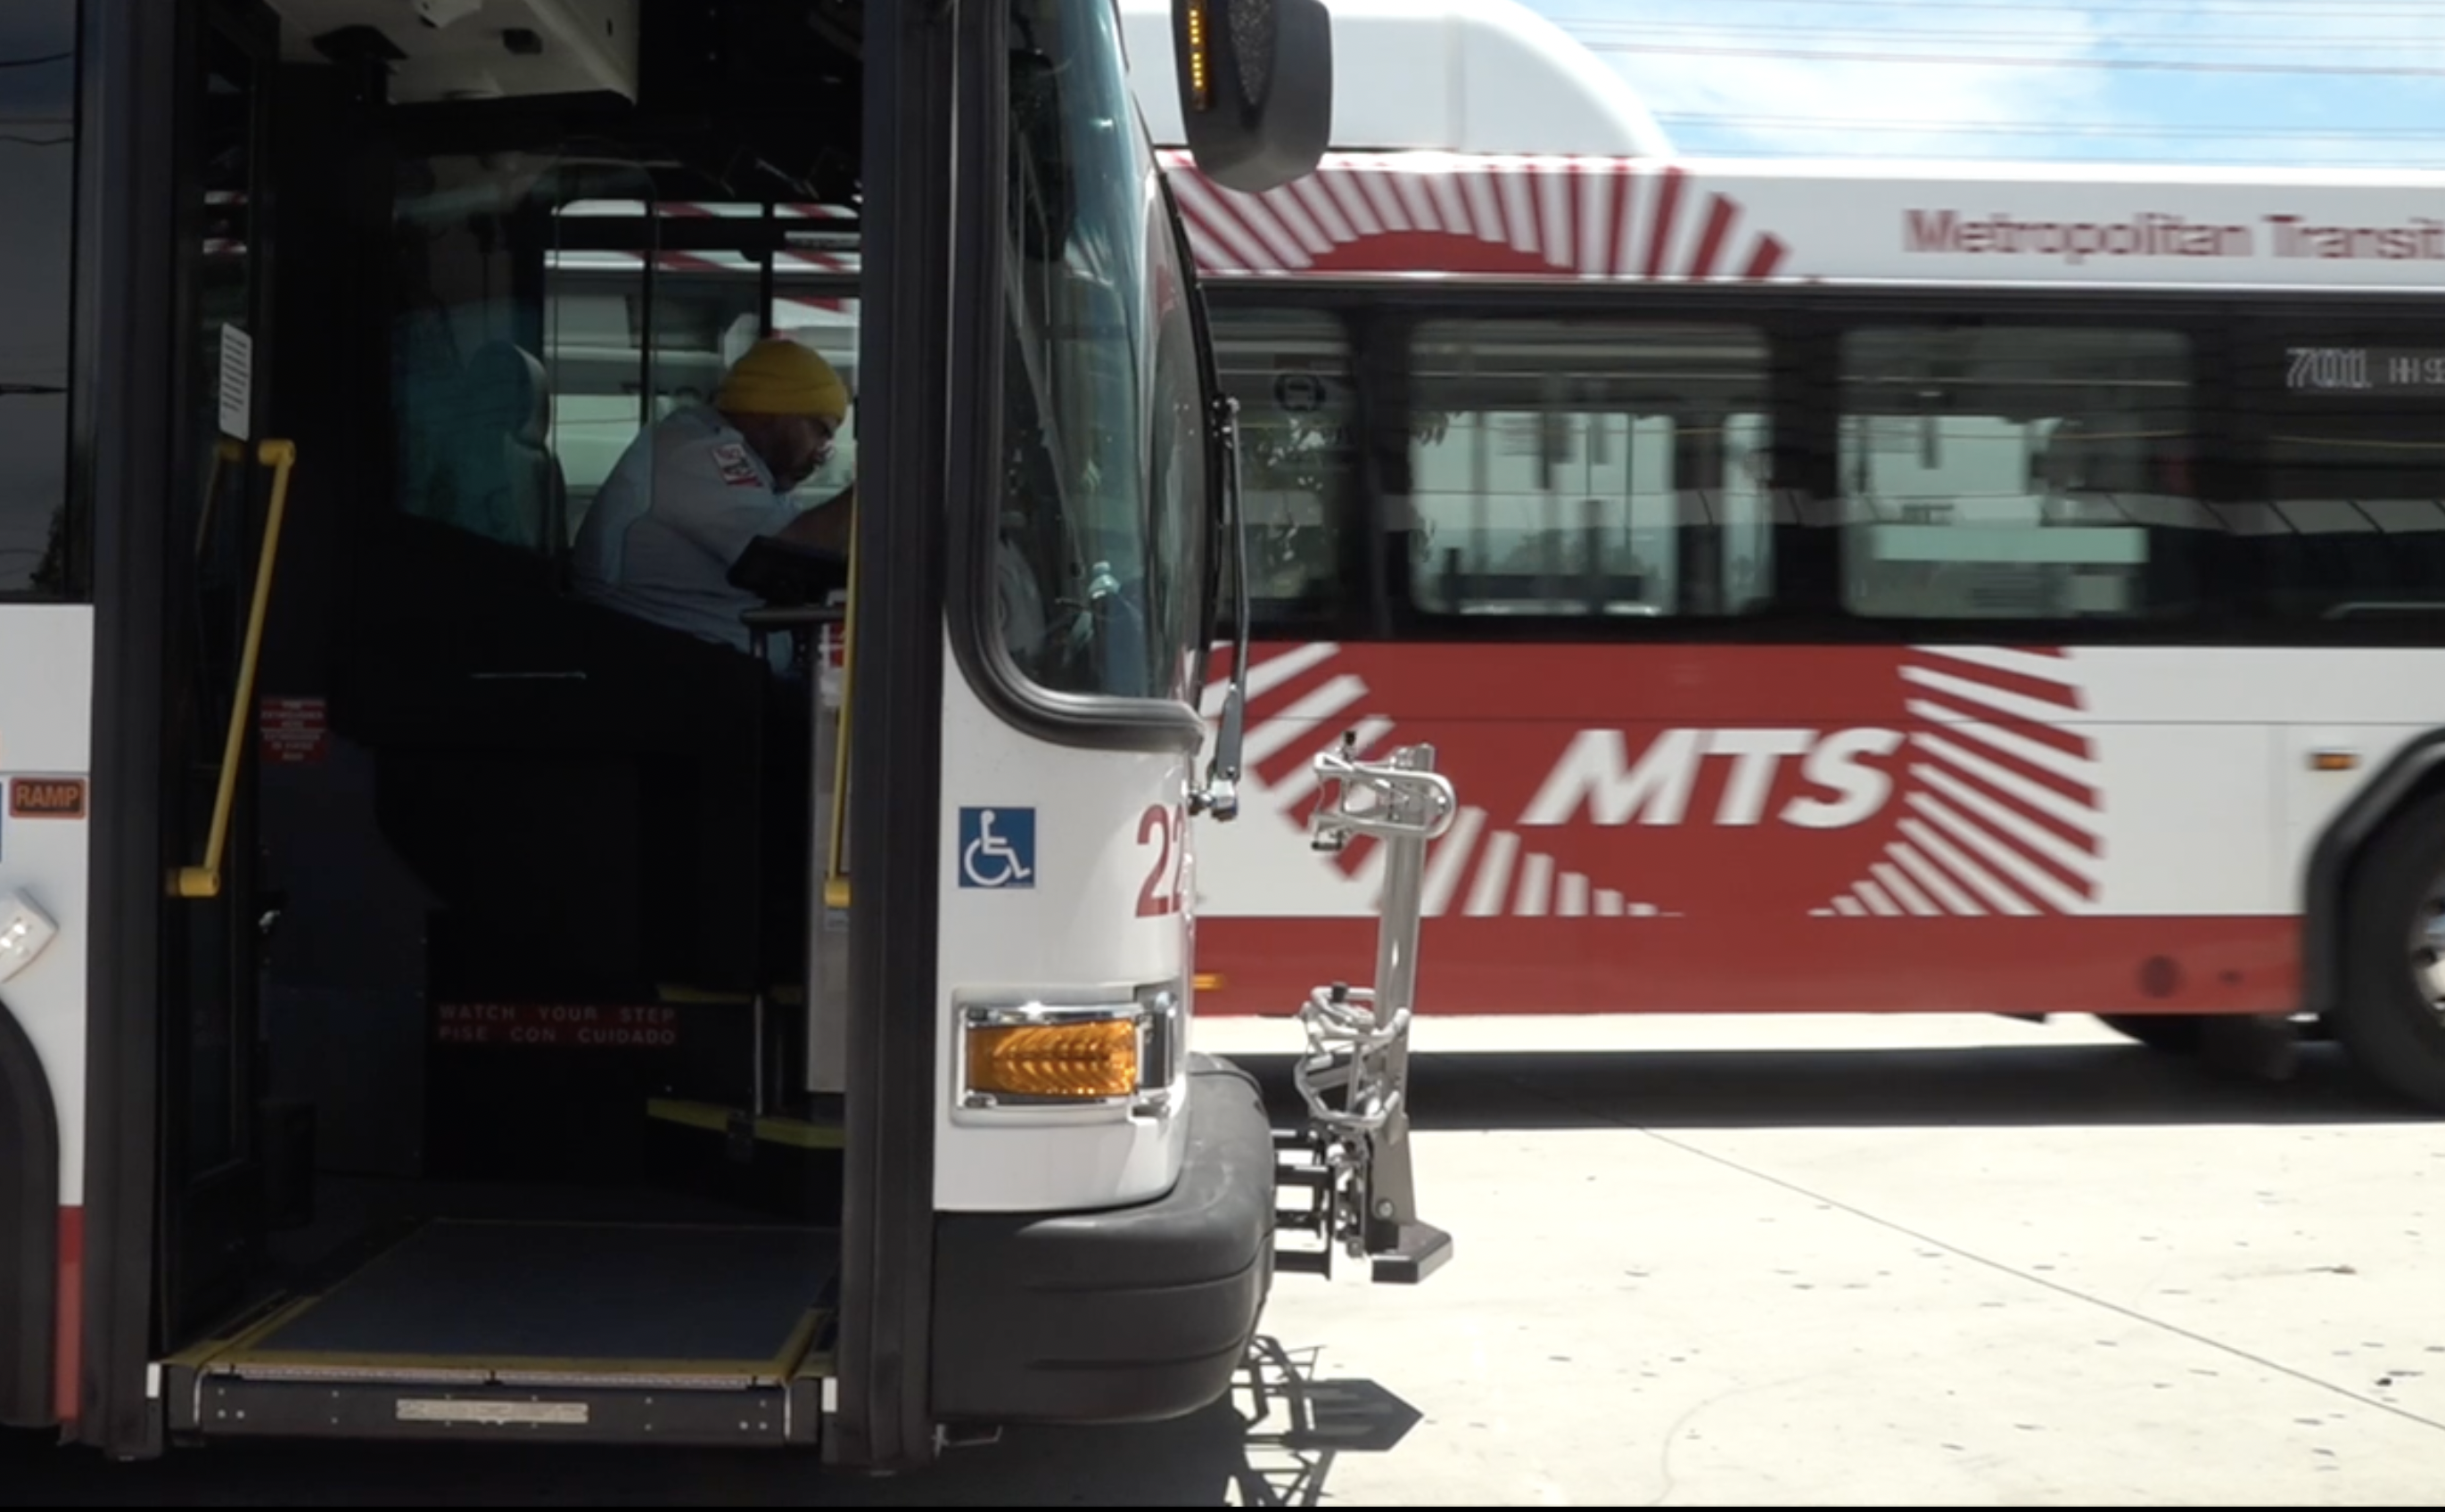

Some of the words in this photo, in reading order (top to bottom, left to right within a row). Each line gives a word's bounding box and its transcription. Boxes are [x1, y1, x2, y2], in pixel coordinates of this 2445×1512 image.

[1904, 209, 2253, 266] Metropolitan
[2260, 214, 2445, 260] Transit
[1515, 727, 1907, 829] MTS
[14, 785, 79, 809] RAMP
[438, 1006, 515, 1021] WATCH
[538, 1006, 598, 1023] YOUR
[620, 1007, 677, 1023] STEP
[438, 1025, 489, 1042] PISE
[509, 1025, 557, 1043] CON
[577, 1027, 677, 1045] CUIDADO
